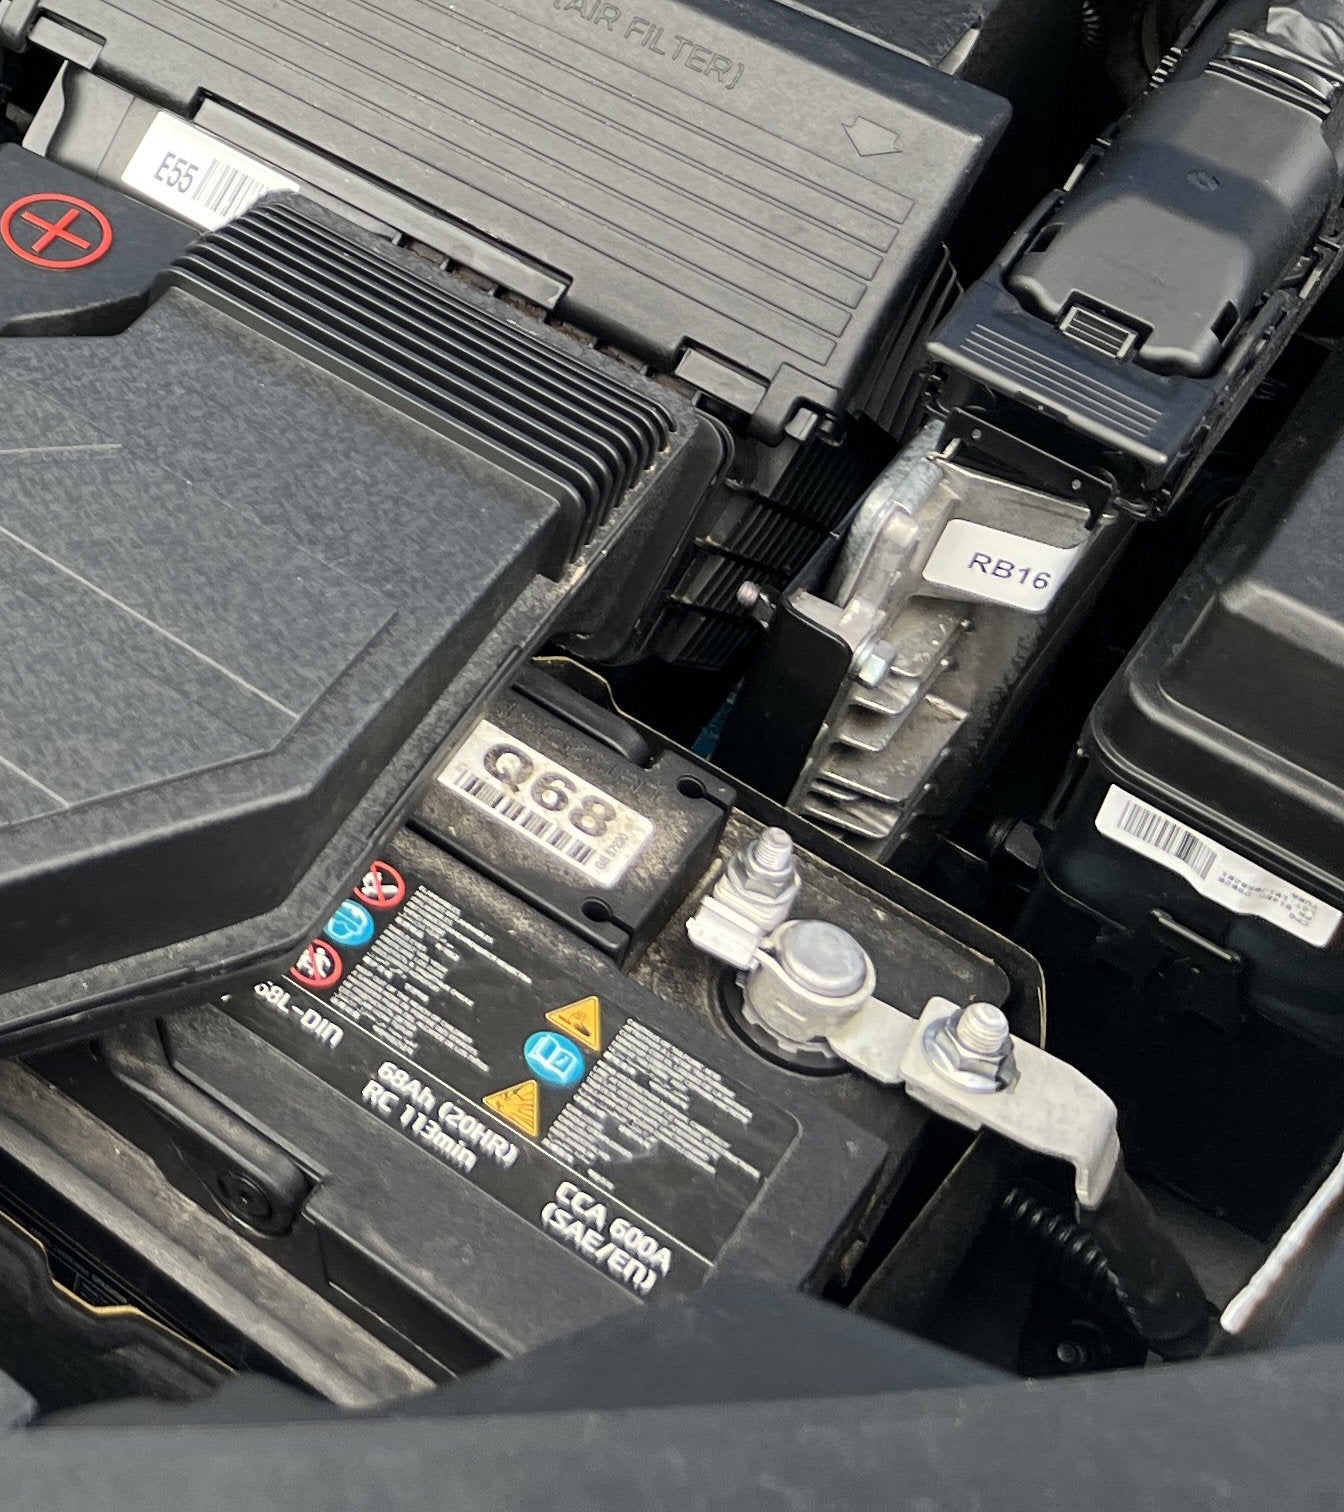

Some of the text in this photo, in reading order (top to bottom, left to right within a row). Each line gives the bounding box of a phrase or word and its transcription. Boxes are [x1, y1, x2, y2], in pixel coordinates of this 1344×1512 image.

[623, 16, 745, 91] FILTER)
[153, 150, 200, 194] E55
[967, 550, 1052, 591] RB16
[481, 741, 618, 839] Q68
[361, 1084, 478, 1172] RC 113min
[376, 1060, 521, 1168] 68Ah (20HR)
[555, 1181, 673, 1272] CCA 600A
